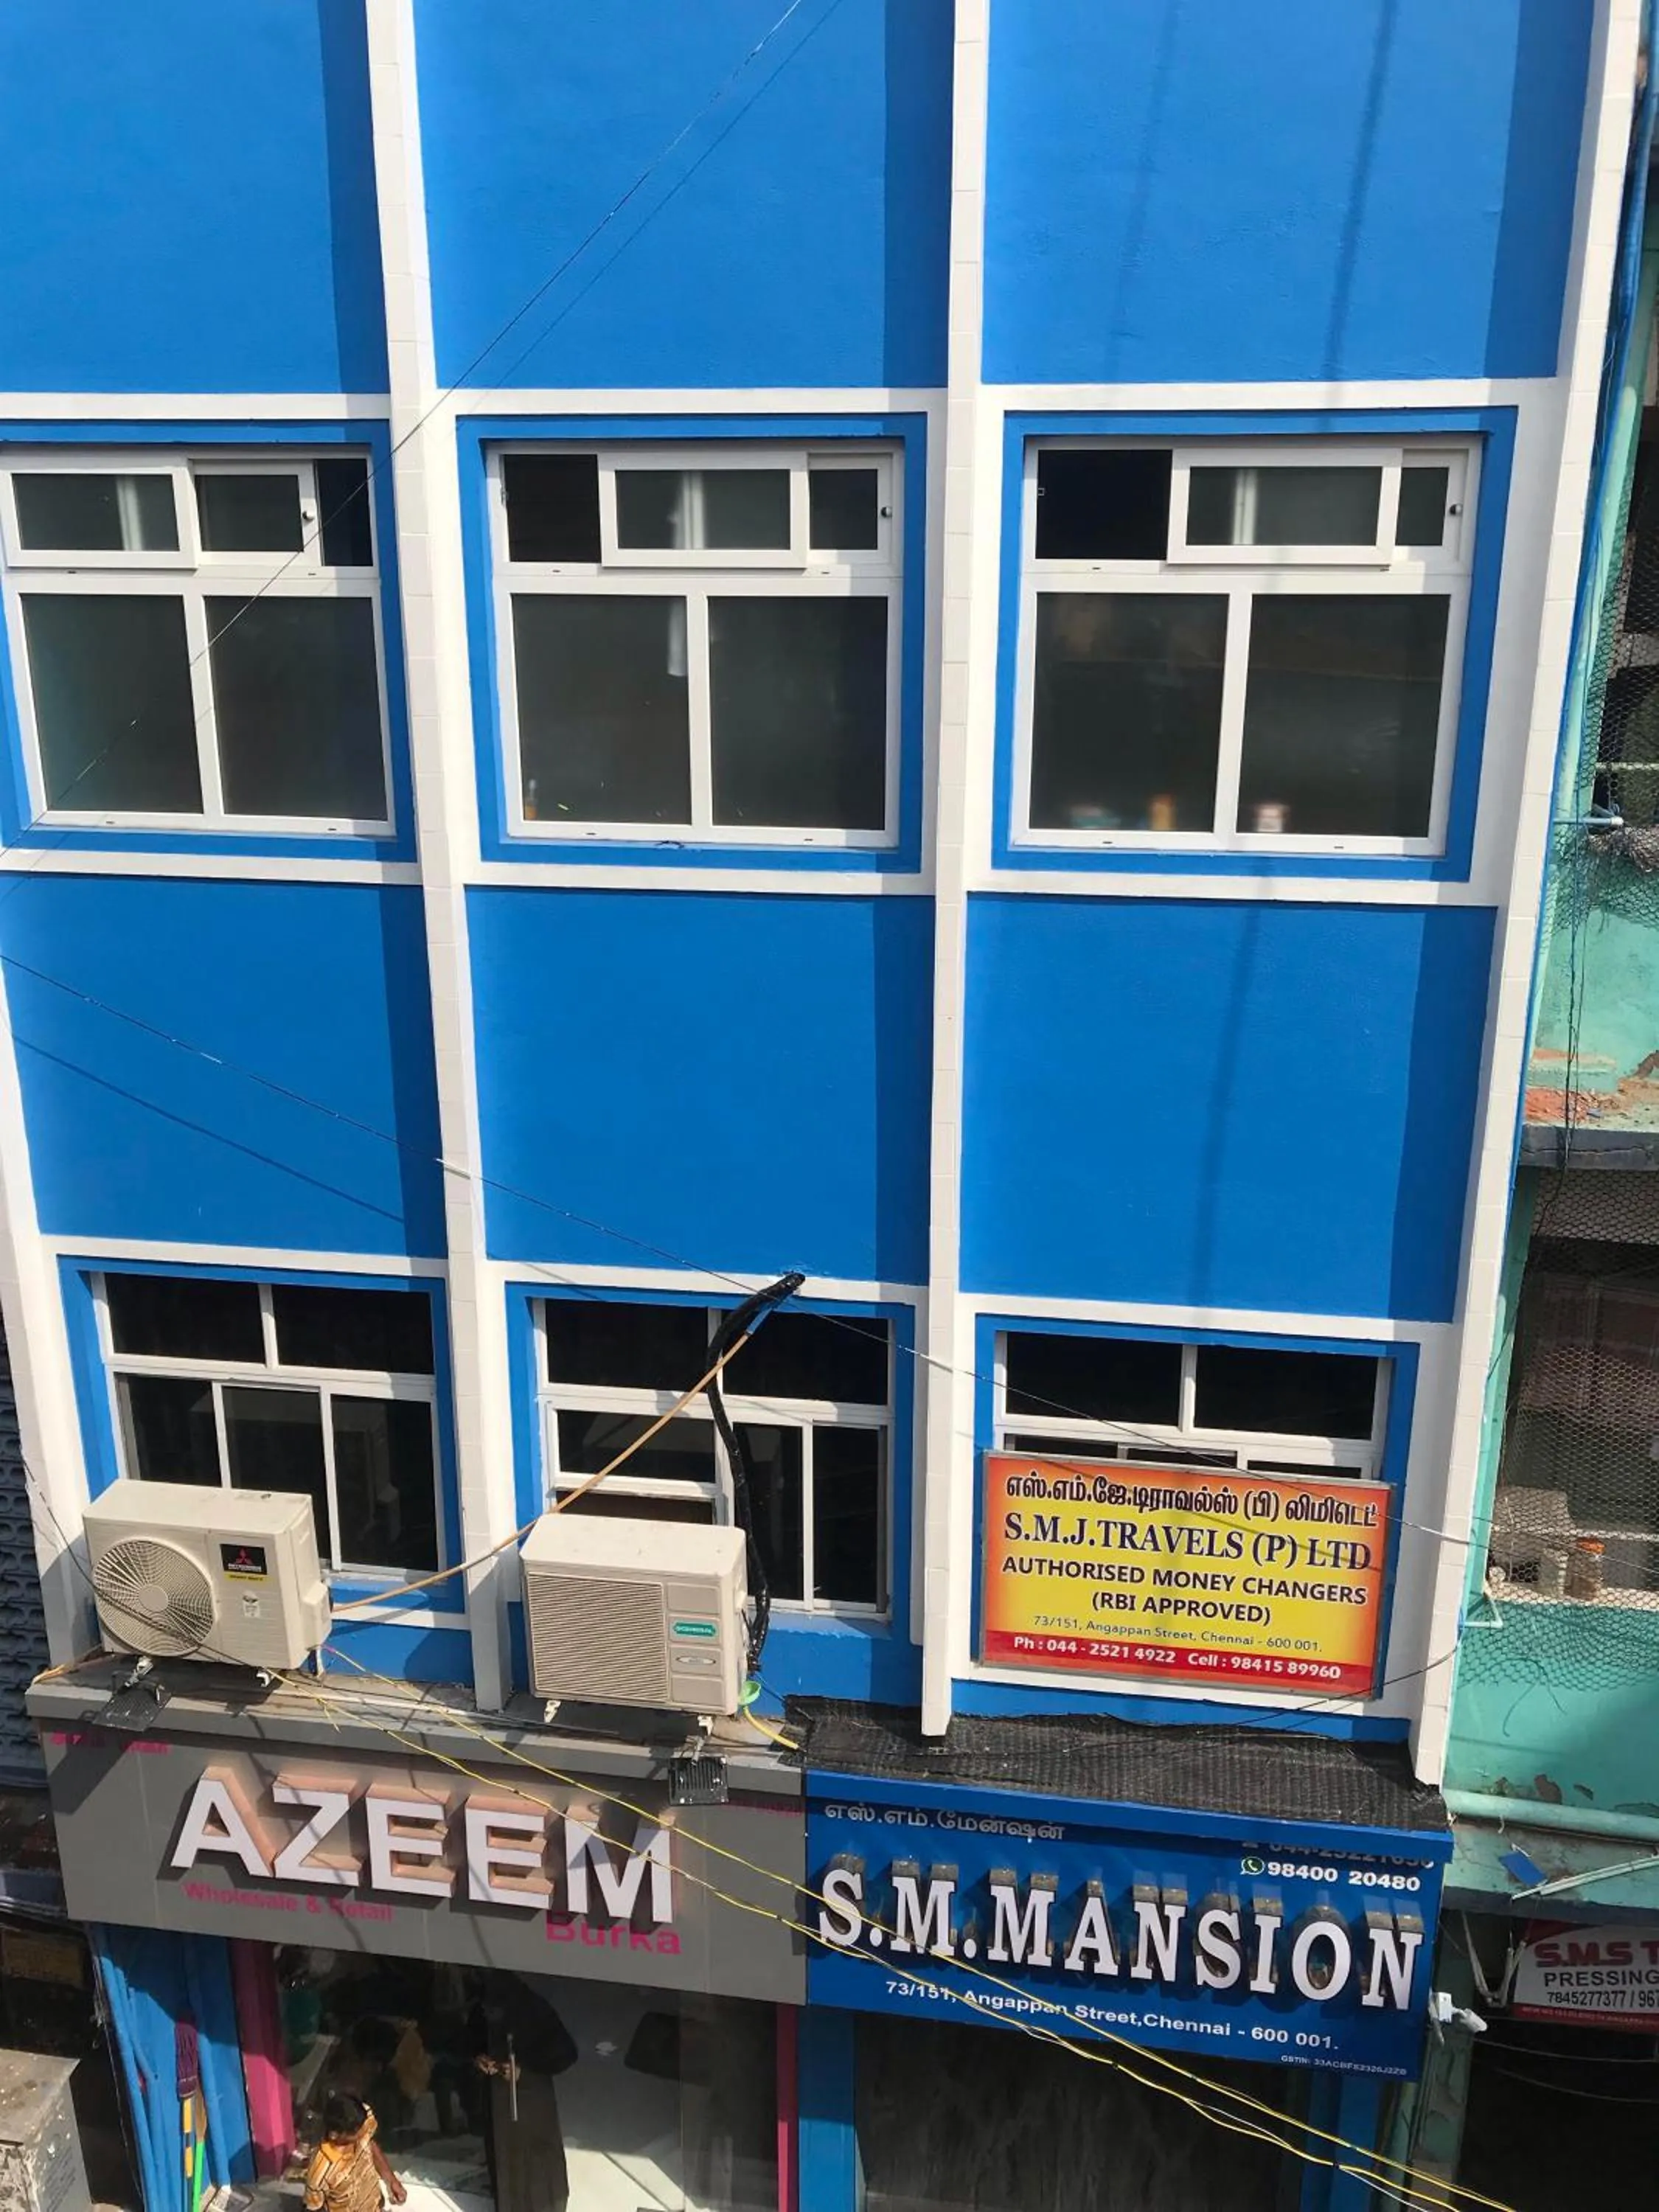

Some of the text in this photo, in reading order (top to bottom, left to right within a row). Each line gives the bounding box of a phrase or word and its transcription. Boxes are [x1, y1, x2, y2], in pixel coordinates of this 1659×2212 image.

[1244, 1490, 1279, 1522] (பி)
[1253, 1532, 1298, 1569] (P)
[1307, 1538, 1371, 1570] LTD
[1002, 1557, 1367, 1604] AUTHORISED MONEY CHANGERS
[1092, 1592, 1271, 1627] (RBI APPROVED)
[1034, 1615, 1082, 1631] 73/151,
[1086, 1620, 1151, 1637] Angappan
[1200, 1630, 1254, 1645] Chennai
[1266, 1637, 1291, 1649] 600
[1294, 1640, 1323, 1652] 001.
[1014, 1635, 1034, 1649] Ph
[1046, 1638, 1077, 1653] 044
[1089, 1643, 1130, 1658] 2521
[1134, 1648, 1177, 1663] 4922
[1188, 1652, 1218, 1667] Cell
[1231, 1657, 1285, 1674] 98415
[1287, 1661, 1342, 1680] 89960
[170, 1770, 675, 1924] AZEEM
[1267, 1861, 1421, 1892] 98400 20480
[181, 1881, 299, 1913] Wholesale
[306, 1893, 321, 1913] &
[545, 1908, 683, 1955] Burka
[1544, 1969, 1659, 1987] PRESSING
[886, 1980, 957, 2003] 73/151,
[963, 1989, 1068, 2016] Angappan
[1251, 2026, 1290, 2043] 600
[1295, 2031, 1339, 2050] 001.
[1547, 1990, 1627, 2008] 7845277377
